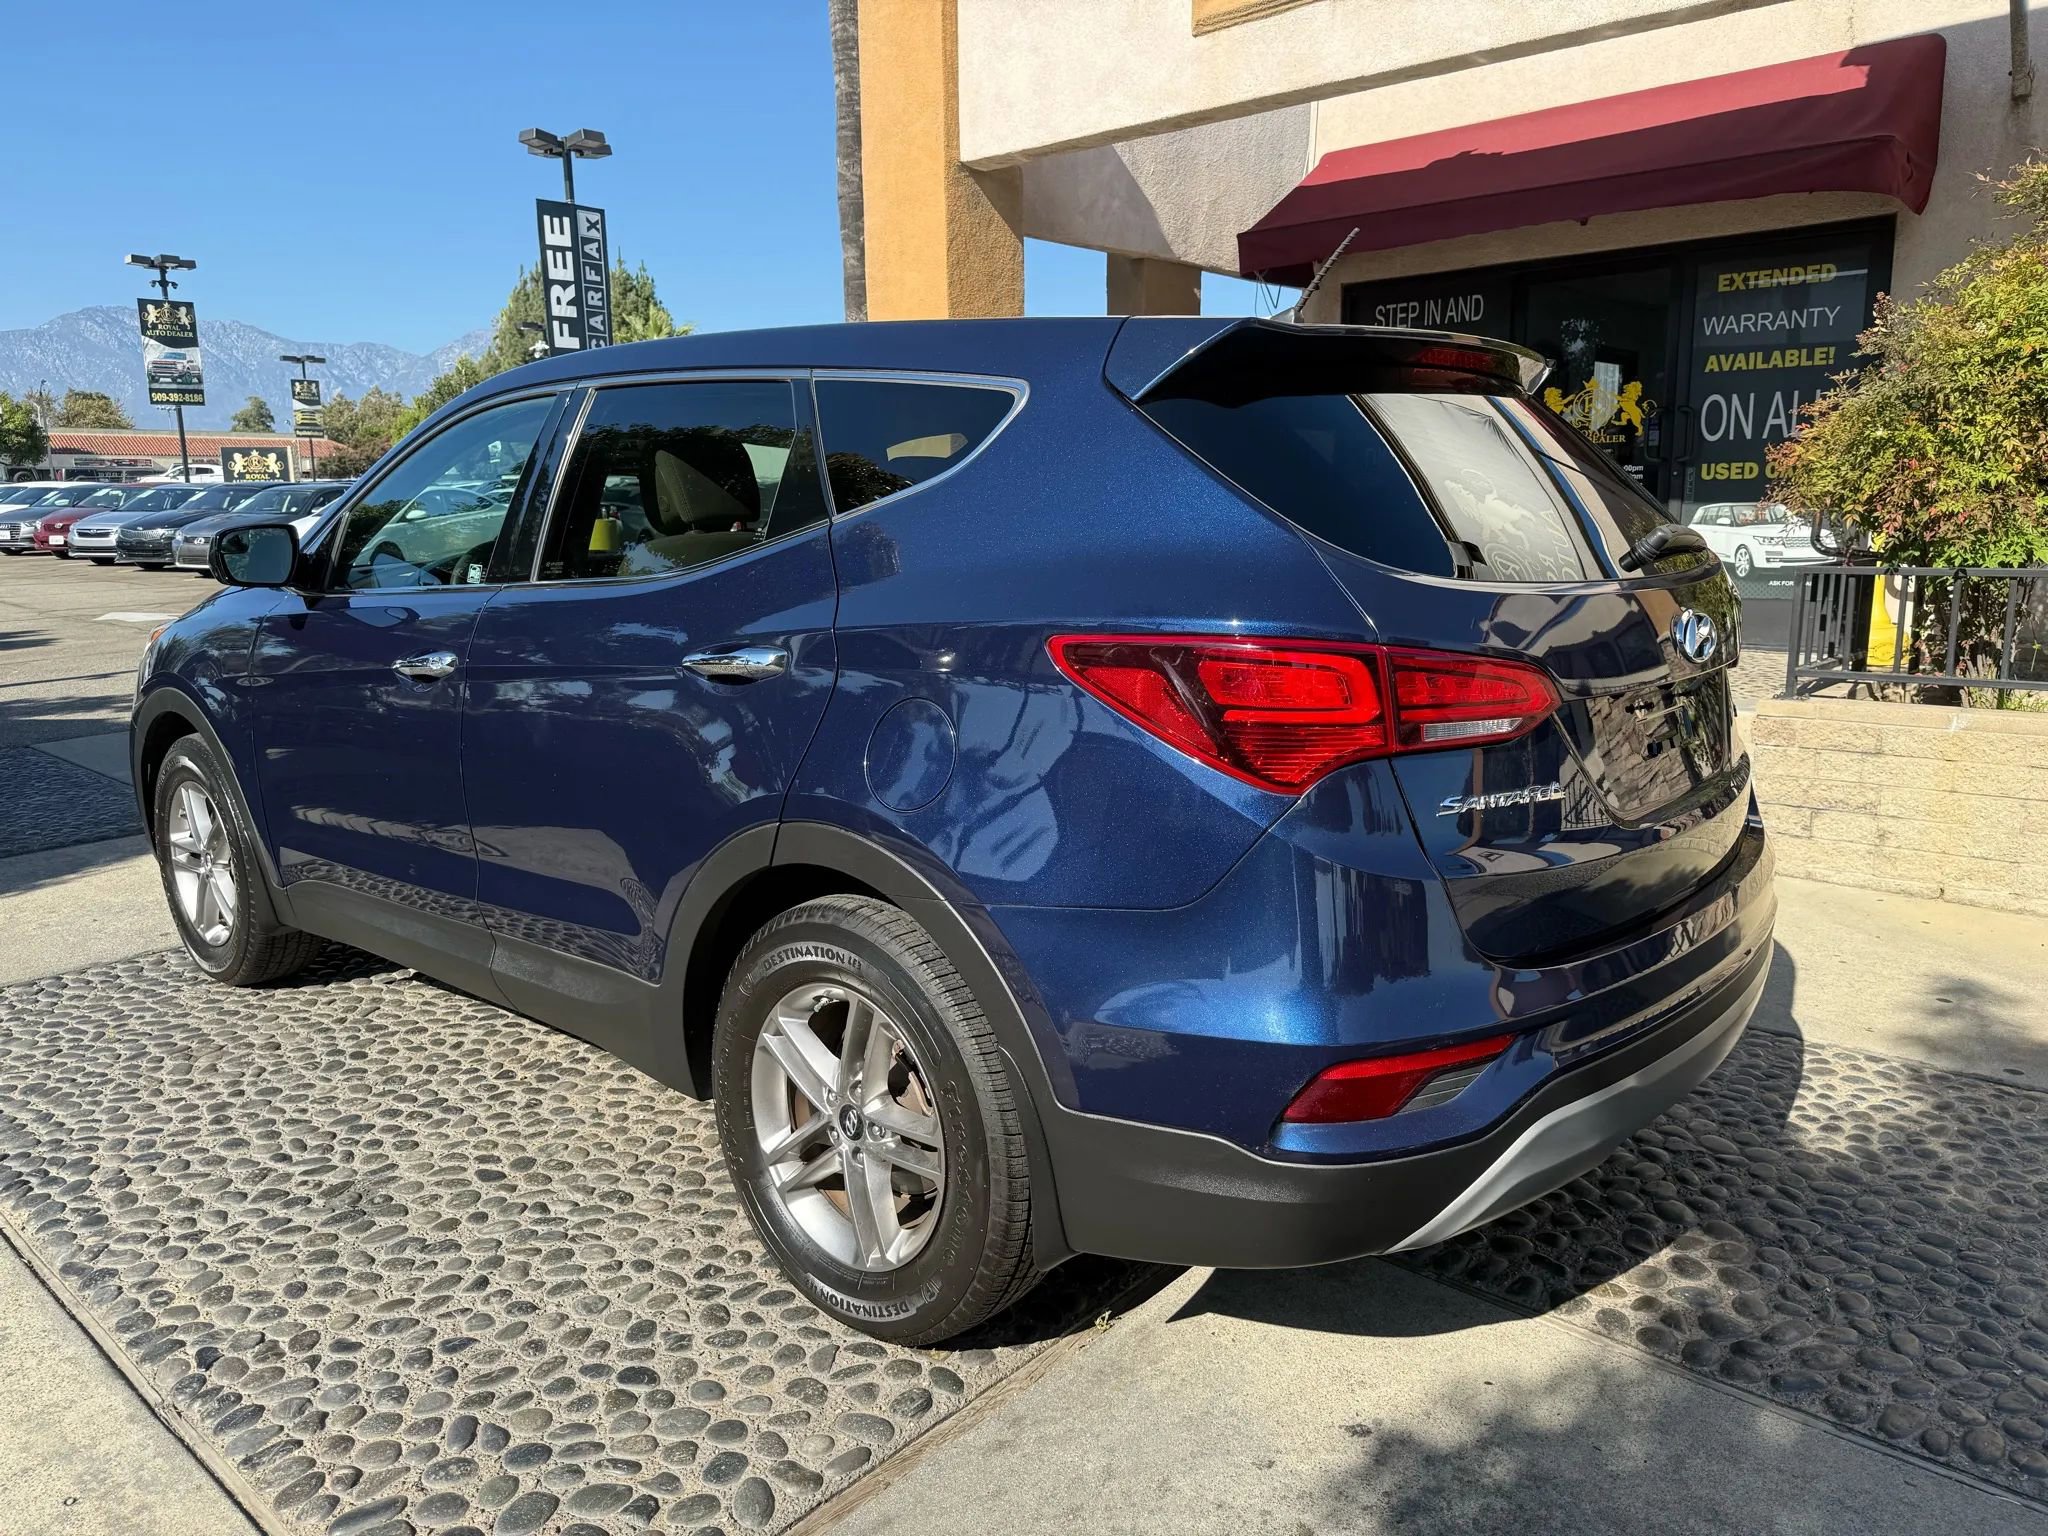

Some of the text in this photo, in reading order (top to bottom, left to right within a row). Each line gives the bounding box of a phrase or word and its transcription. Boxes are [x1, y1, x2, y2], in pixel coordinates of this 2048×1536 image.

[543, 214, 580, 350] FREE
[583, 214, 607, 350] CARFAX
[1717, 263, 1838, 292] EXTENDED
[1374, 294, 1484, 328] STEP IN AND
[1702, 305, 1841, 336] WARRANTY
[1704, 346, 1836, 373] AVAILABLE!
[1701, 392, 1755, 442] ON
[1701, 462, 1759, 480] USED
[763, 945, 846, 971] DESTINATION
